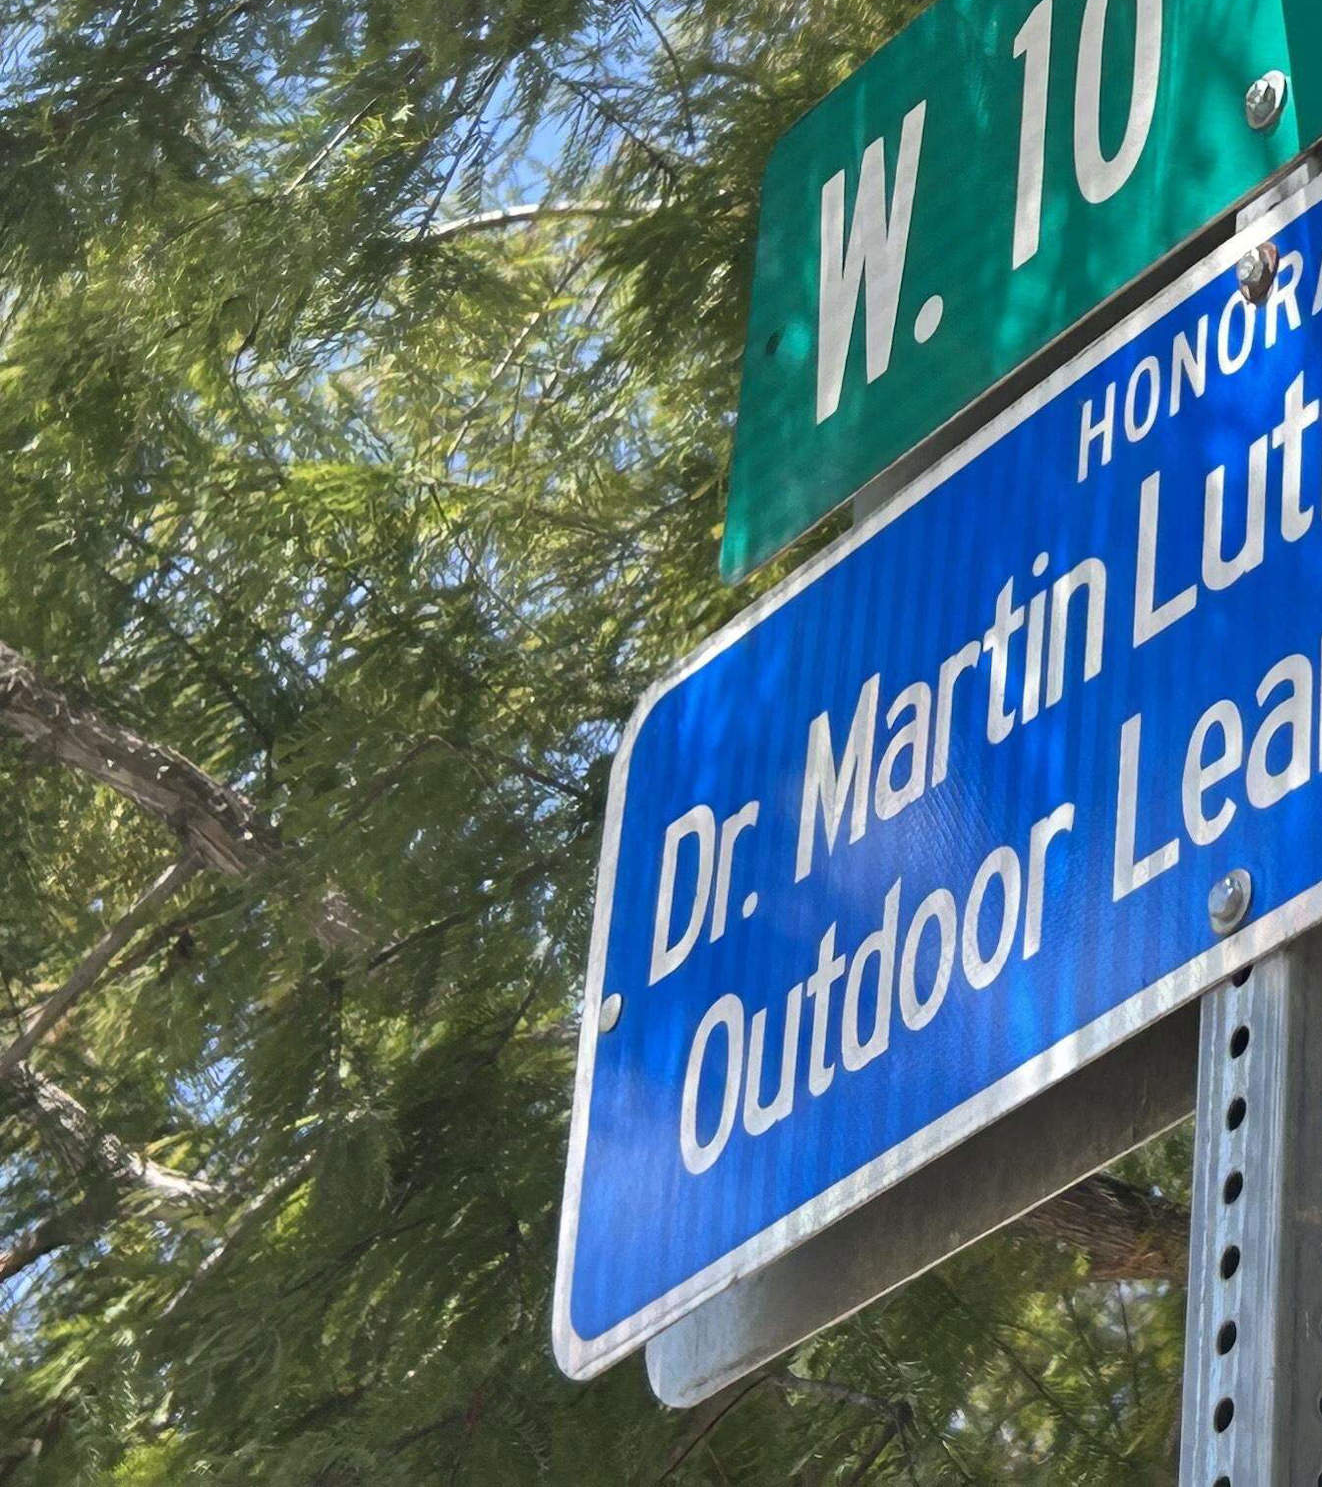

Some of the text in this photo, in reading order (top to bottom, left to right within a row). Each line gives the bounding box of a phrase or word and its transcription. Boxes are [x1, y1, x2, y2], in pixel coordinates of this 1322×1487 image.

[817, 99, 943, 425] W.
[648, 800, 759, 987] Dr.
[795, 551, 1107, 883] Martin
[680, 802, 1075, 1176] Outdoor
